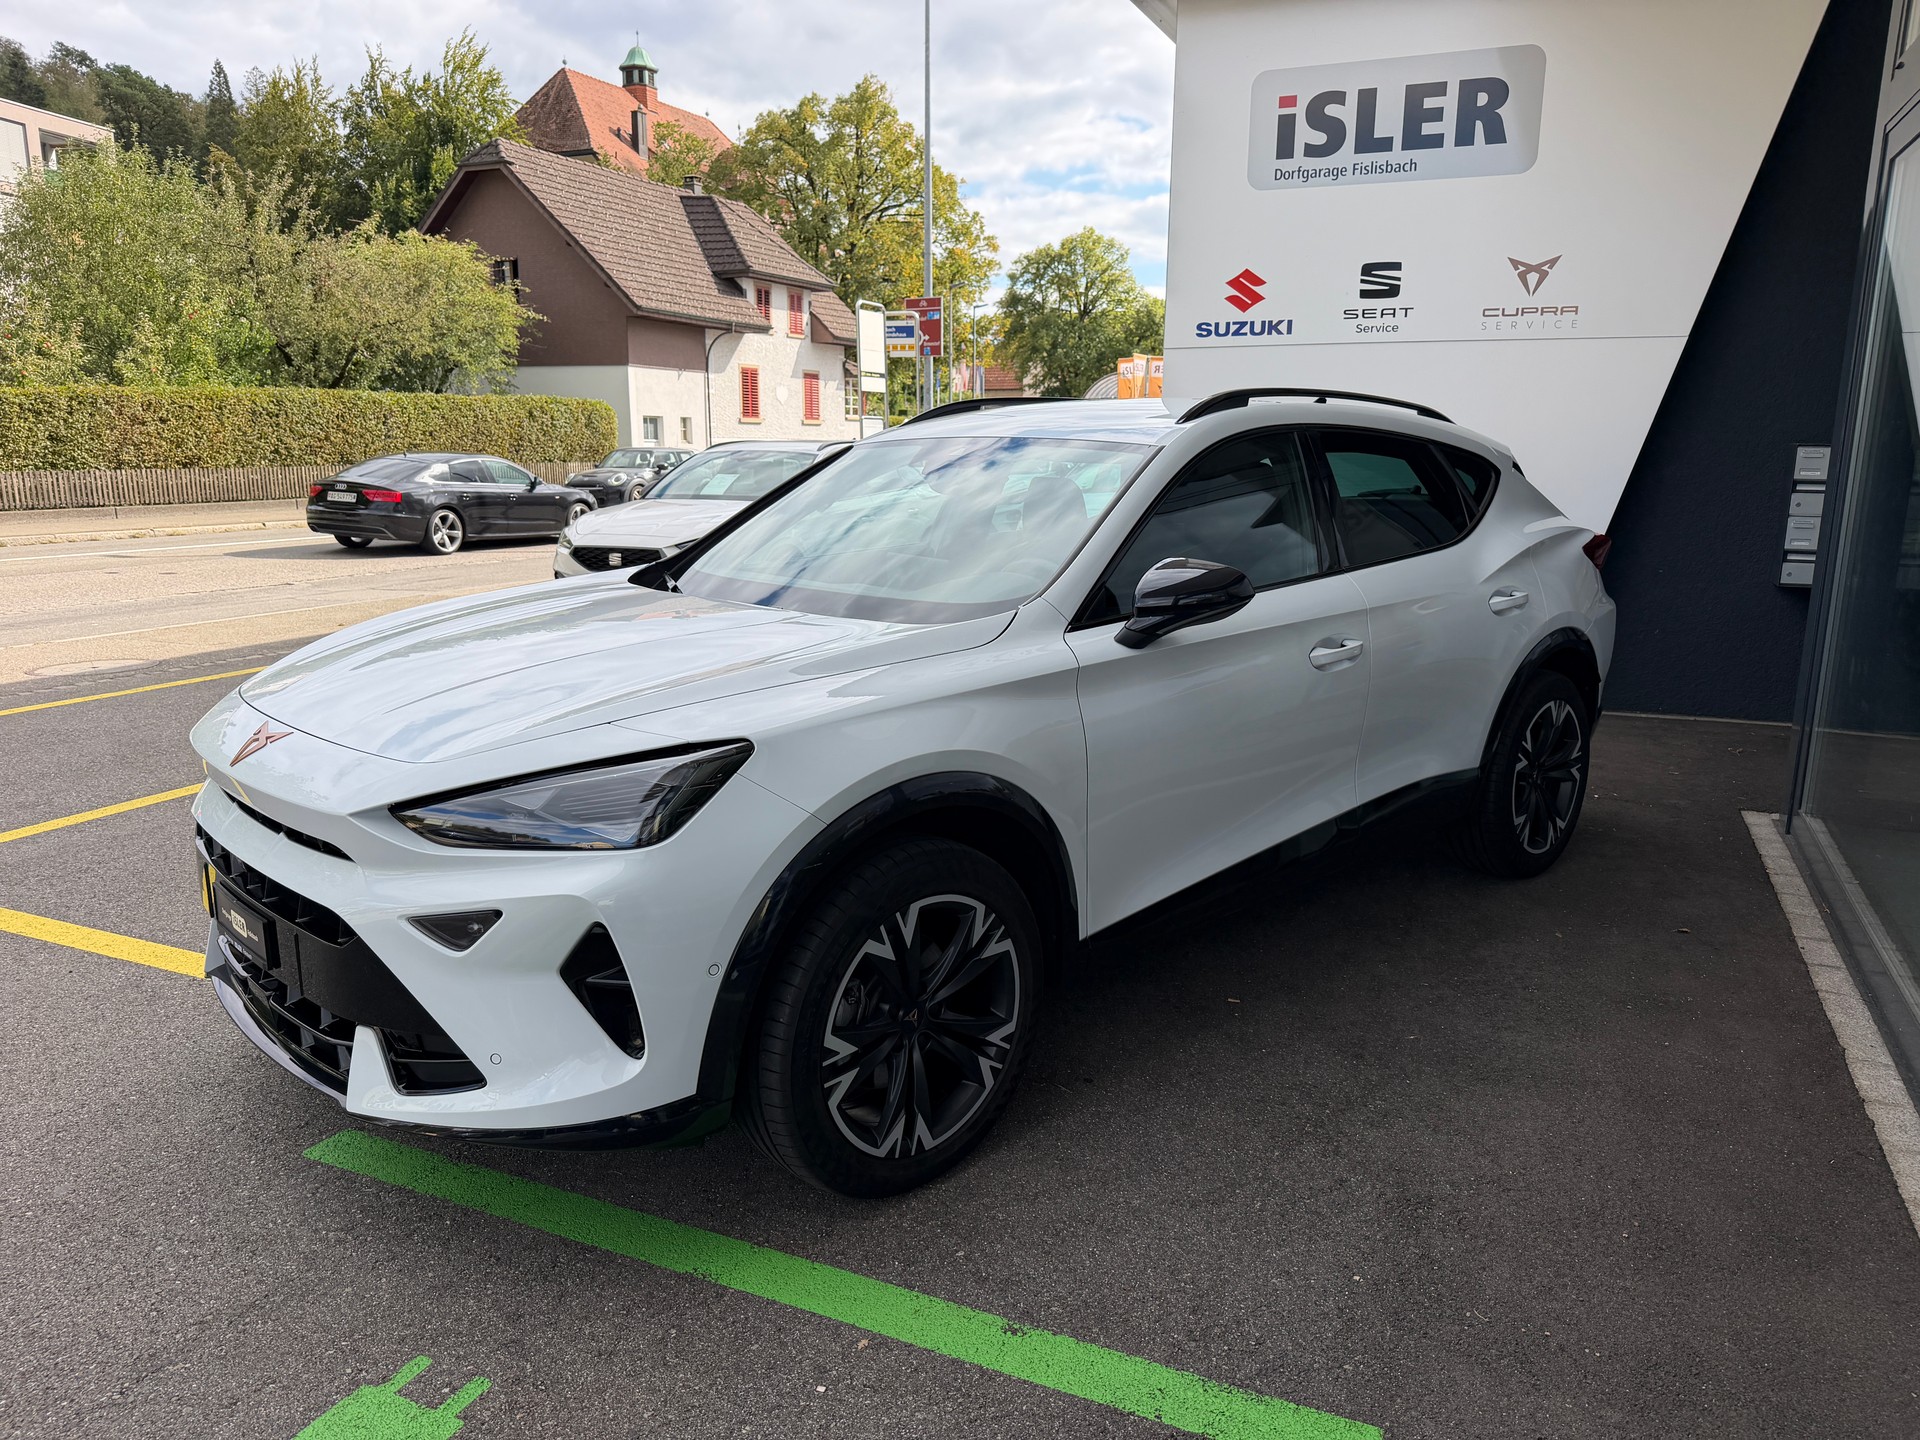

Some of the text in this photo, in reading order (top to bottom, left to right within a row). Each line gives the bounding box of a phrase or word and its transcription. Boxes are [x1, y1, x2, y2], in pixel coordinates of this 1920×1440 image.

[1275, 76, 1510, 160] iSLER
[1274, 157, 1418, 183] Dorfgarage Fislisbach
[1343, 306, 1414, 320] SEAT
[1482, 305, 1579, 318] CUPRA
[1195, 319, 1293, 338] SUZUKI
[1355, 322, 1399, 334] Service
[1480, 319, 1579, 331] SERVICE
